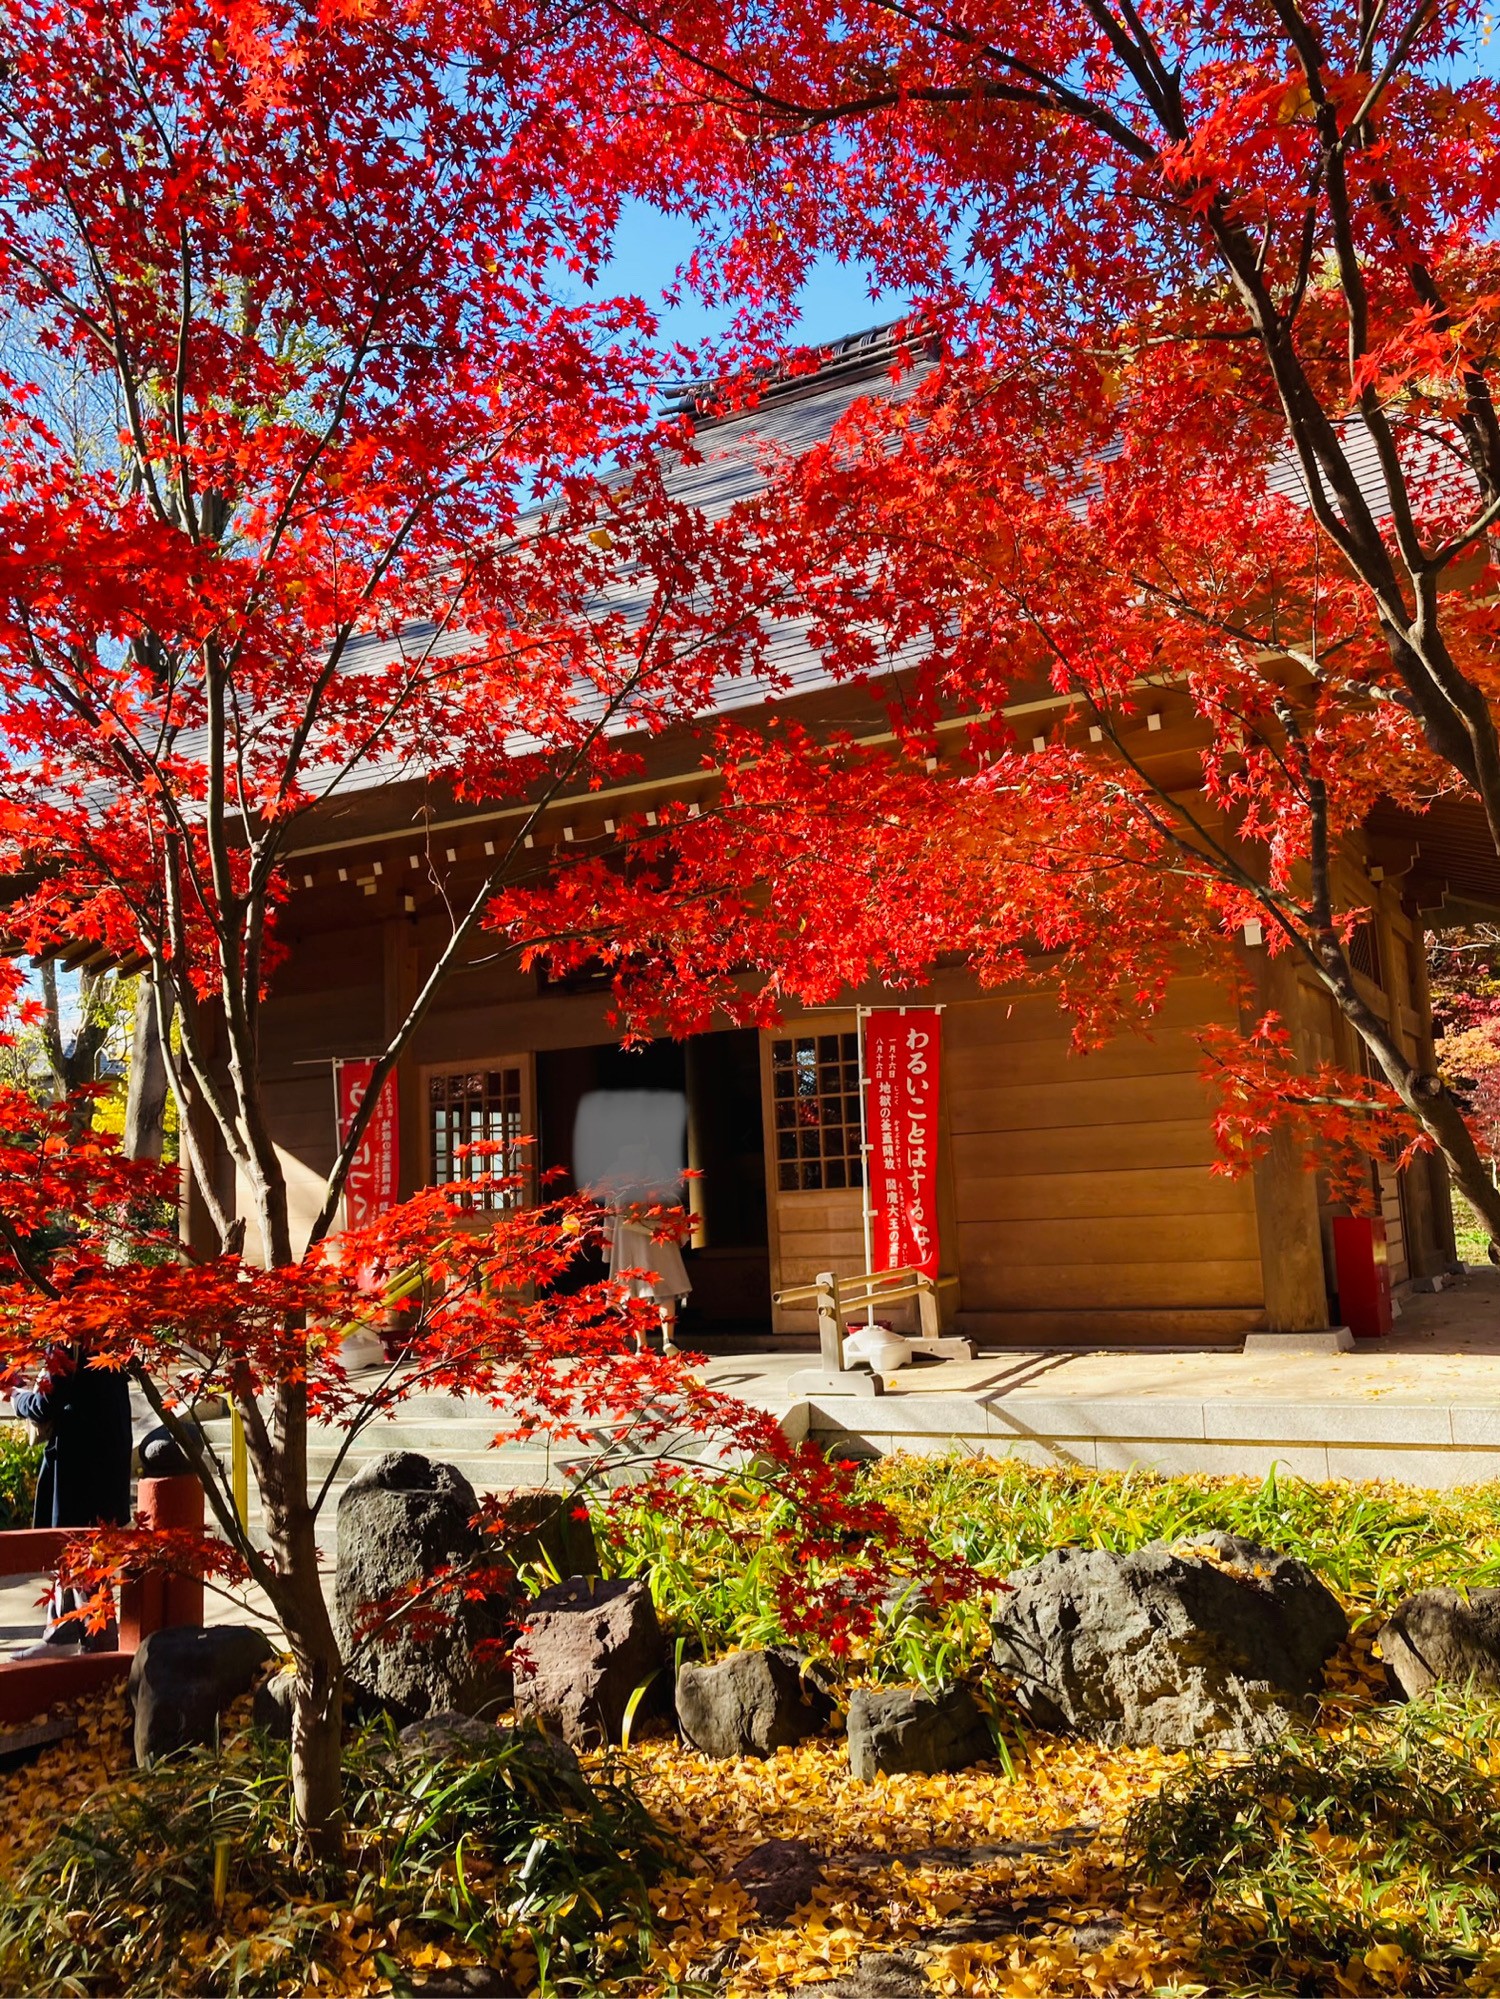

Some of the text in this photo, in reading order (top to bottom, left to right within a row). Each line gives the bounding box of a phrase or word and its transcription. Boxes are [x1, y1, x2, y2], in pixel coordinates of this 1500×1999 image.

[875, 1037, 884, 1079] 八月十六日
[888, 1038, 897, 1079] 一月十六日
